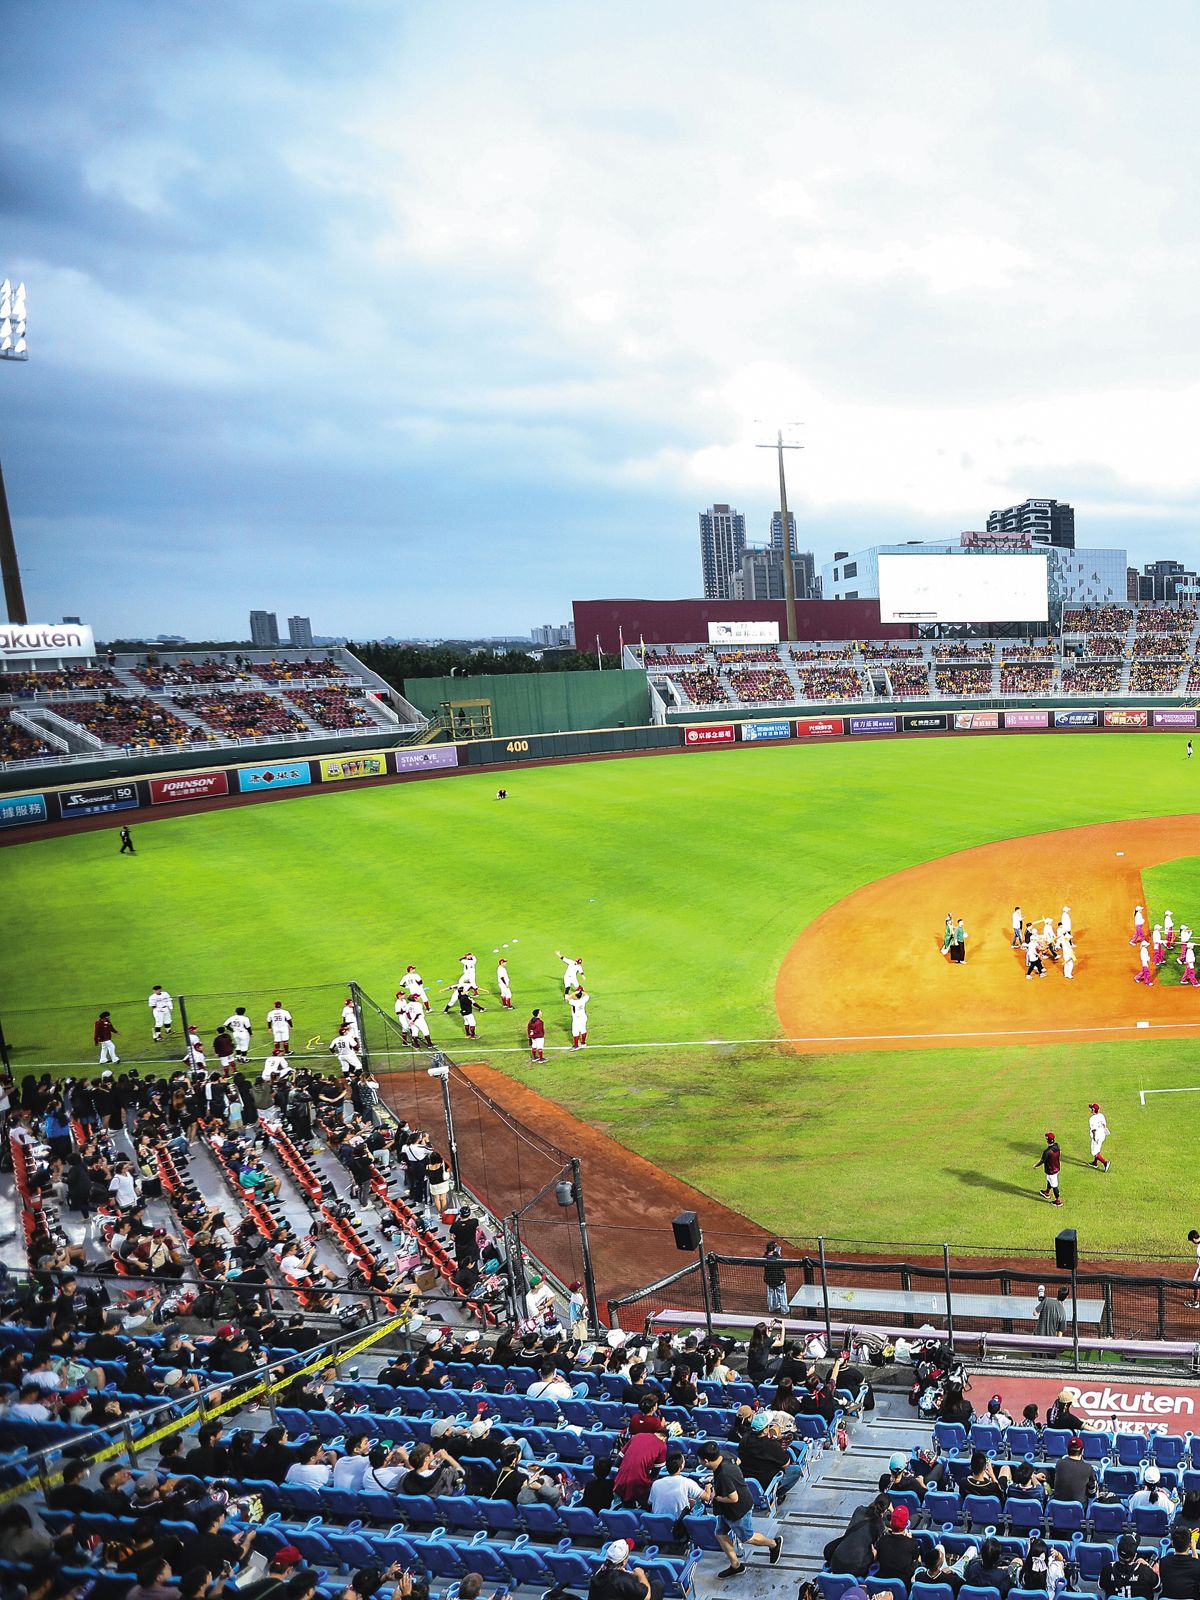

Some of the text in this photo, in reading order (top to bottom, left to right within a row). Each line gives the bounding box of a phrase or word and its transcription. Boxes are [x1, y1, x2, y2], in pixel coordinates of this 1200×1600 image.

[506, 740, 529, 752] 400
[117, 788, 131, 797] 50
[162, 778, 215, 793] JOHNSON
[0, 803, 42, 819] 據服務
[1080, 1418, 1168, 1435] ONKEYS
